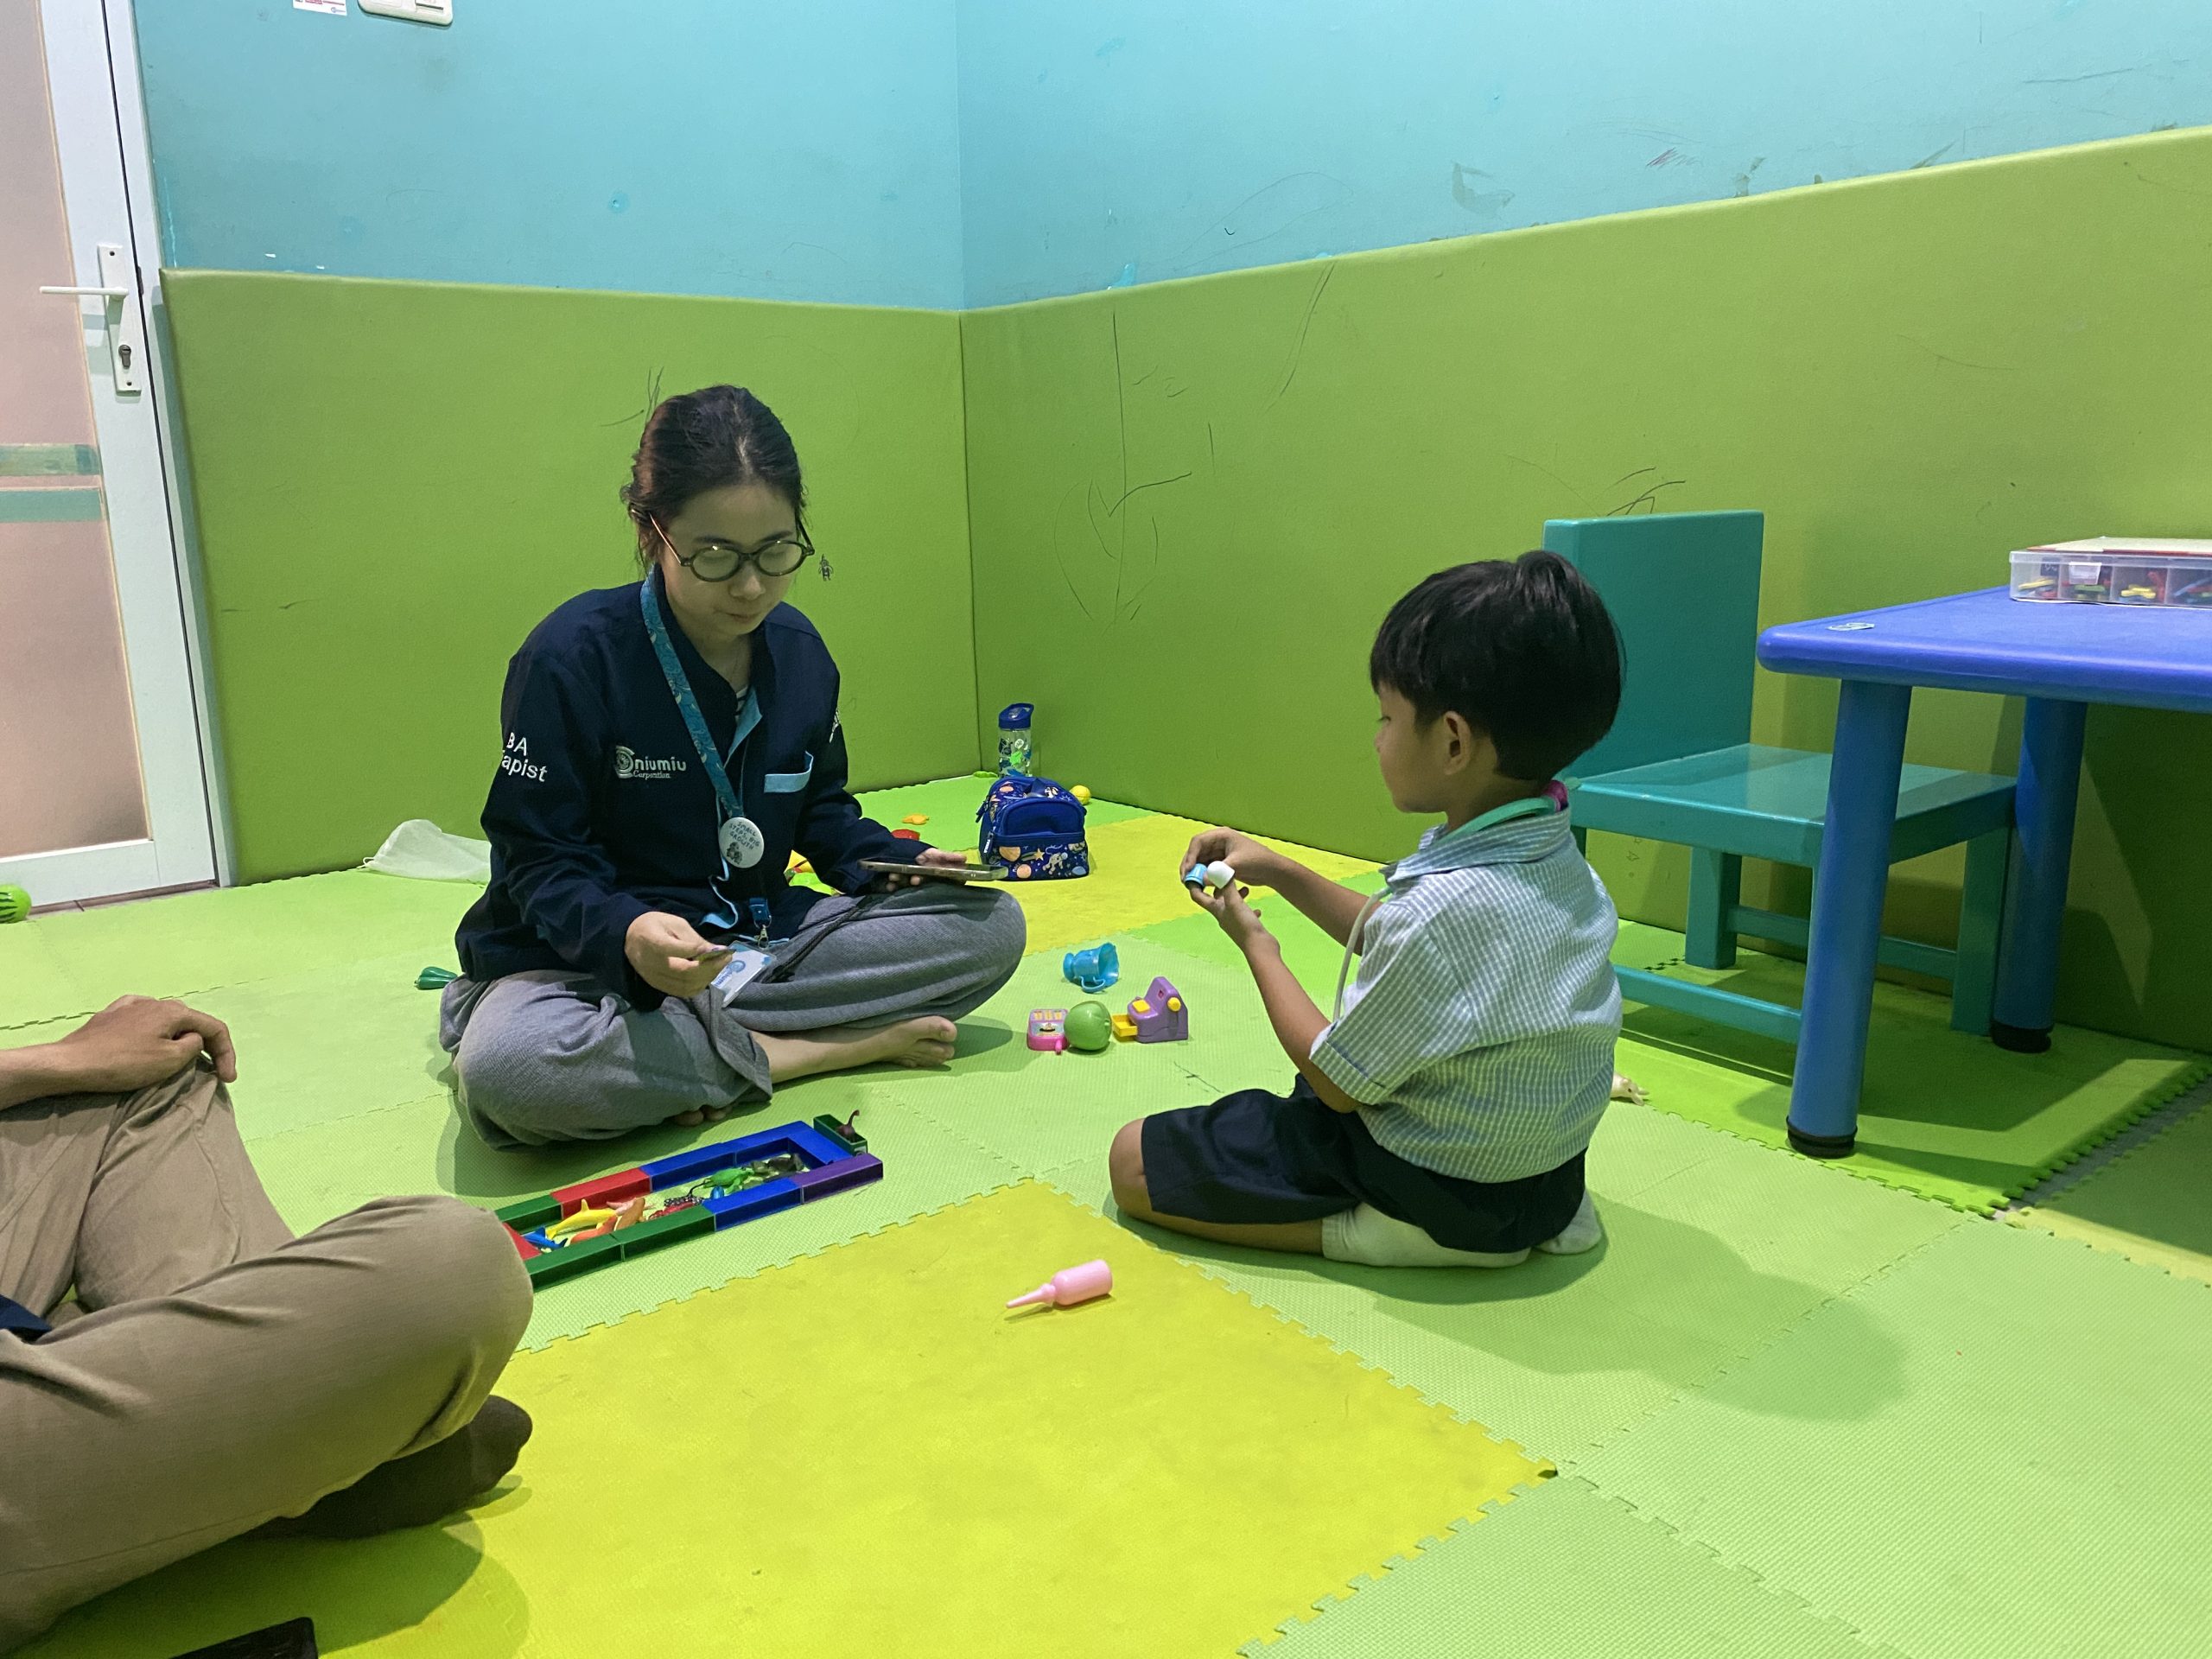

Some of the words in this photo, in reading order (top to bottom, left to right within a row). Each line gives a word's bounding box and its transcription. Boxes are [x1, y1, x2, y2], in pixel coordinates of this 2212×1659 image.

[502, 750, 548, 782] apist
[737, 821, 756, 836] SMALL
[749, 836, 760, 847] BIG
